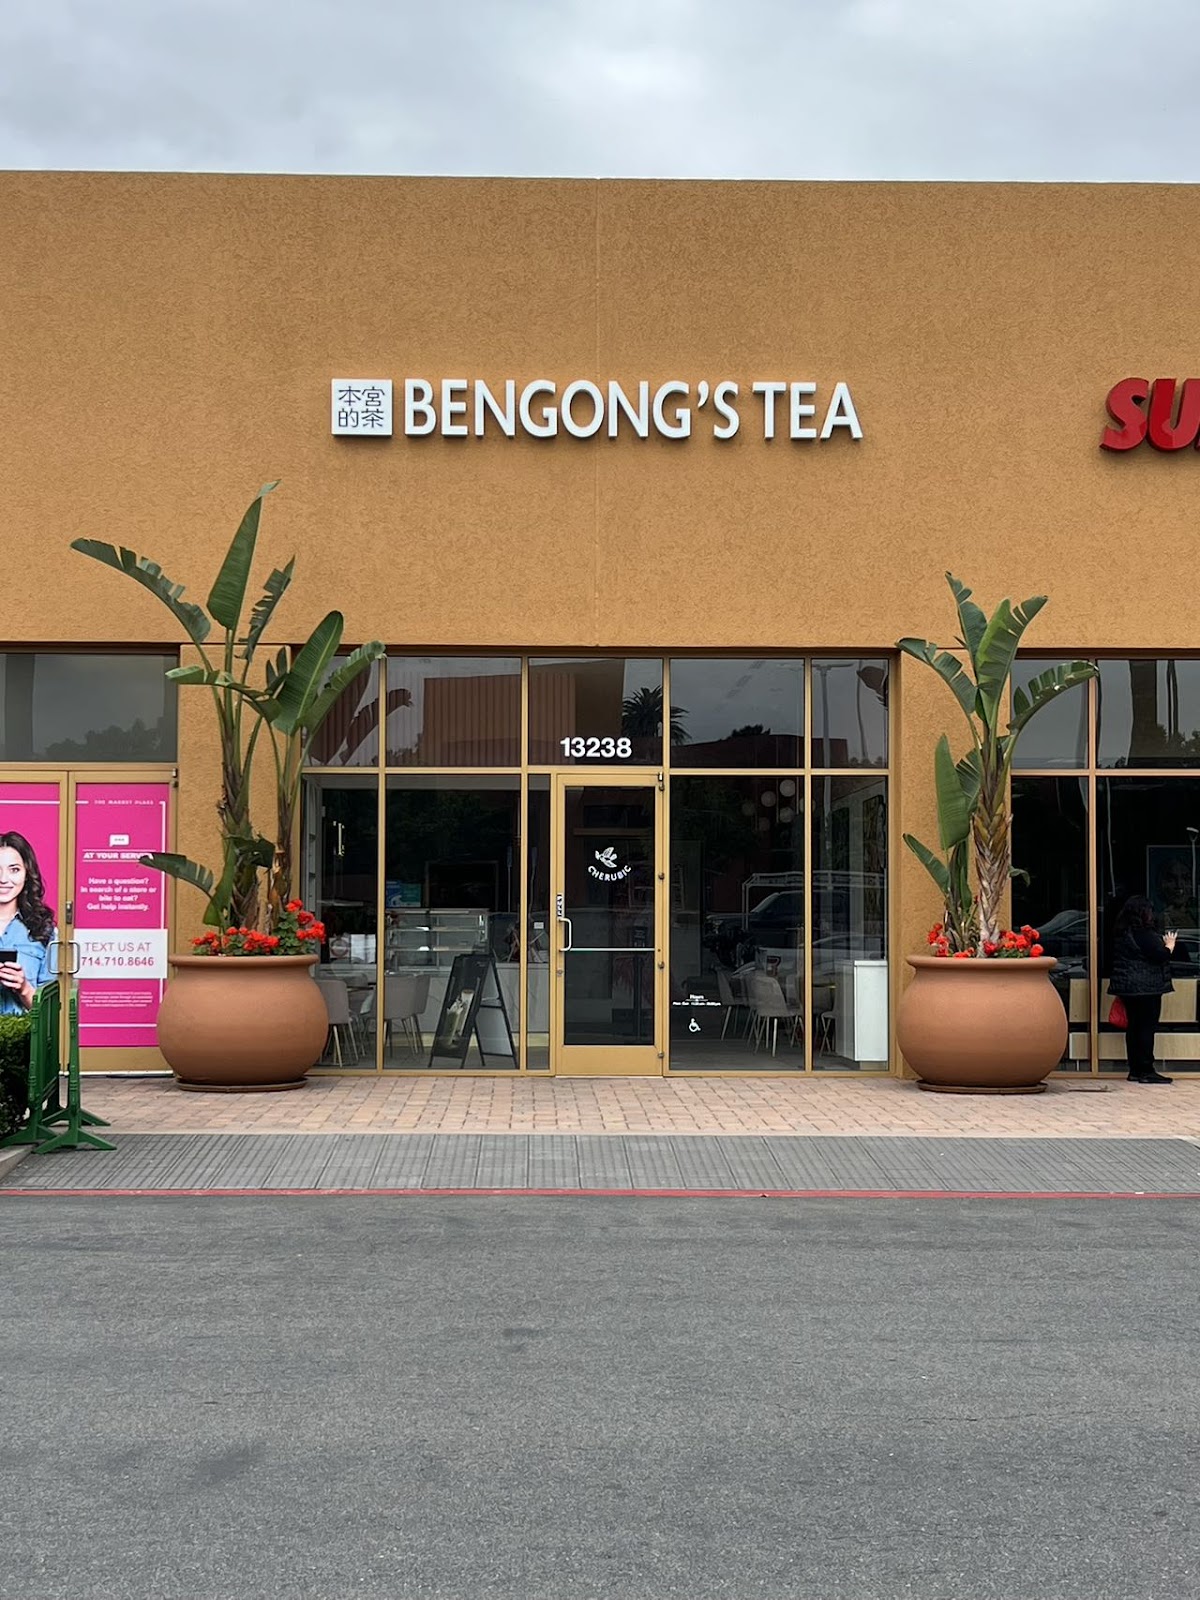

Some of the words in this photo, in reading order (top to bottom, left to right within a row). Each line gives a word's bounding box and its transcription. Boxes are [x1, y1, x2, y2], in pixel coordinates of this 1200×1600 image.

[338, 386, 386, 407] 本宮
[338, 408, 385, 428] 的茶
[404, 378, 741, 440] BENGONG'S
[752, 381, 863, 441] TEA
[1099, 377, 1200, 452] SU
[560, 736, 632, 758] 13238
[88, 877, 107, 885] Have
[114, 877, 149, 886] question?
[588, 865, 632, 881] CHERUBIC
[101, 903, 117, 911] help
[85, 942, 114, 952] TEXT
[118, 942, 134, 952] US
[137, 942, 152, 952] AT
[81, 957, 154, 966] 714.710.8646
